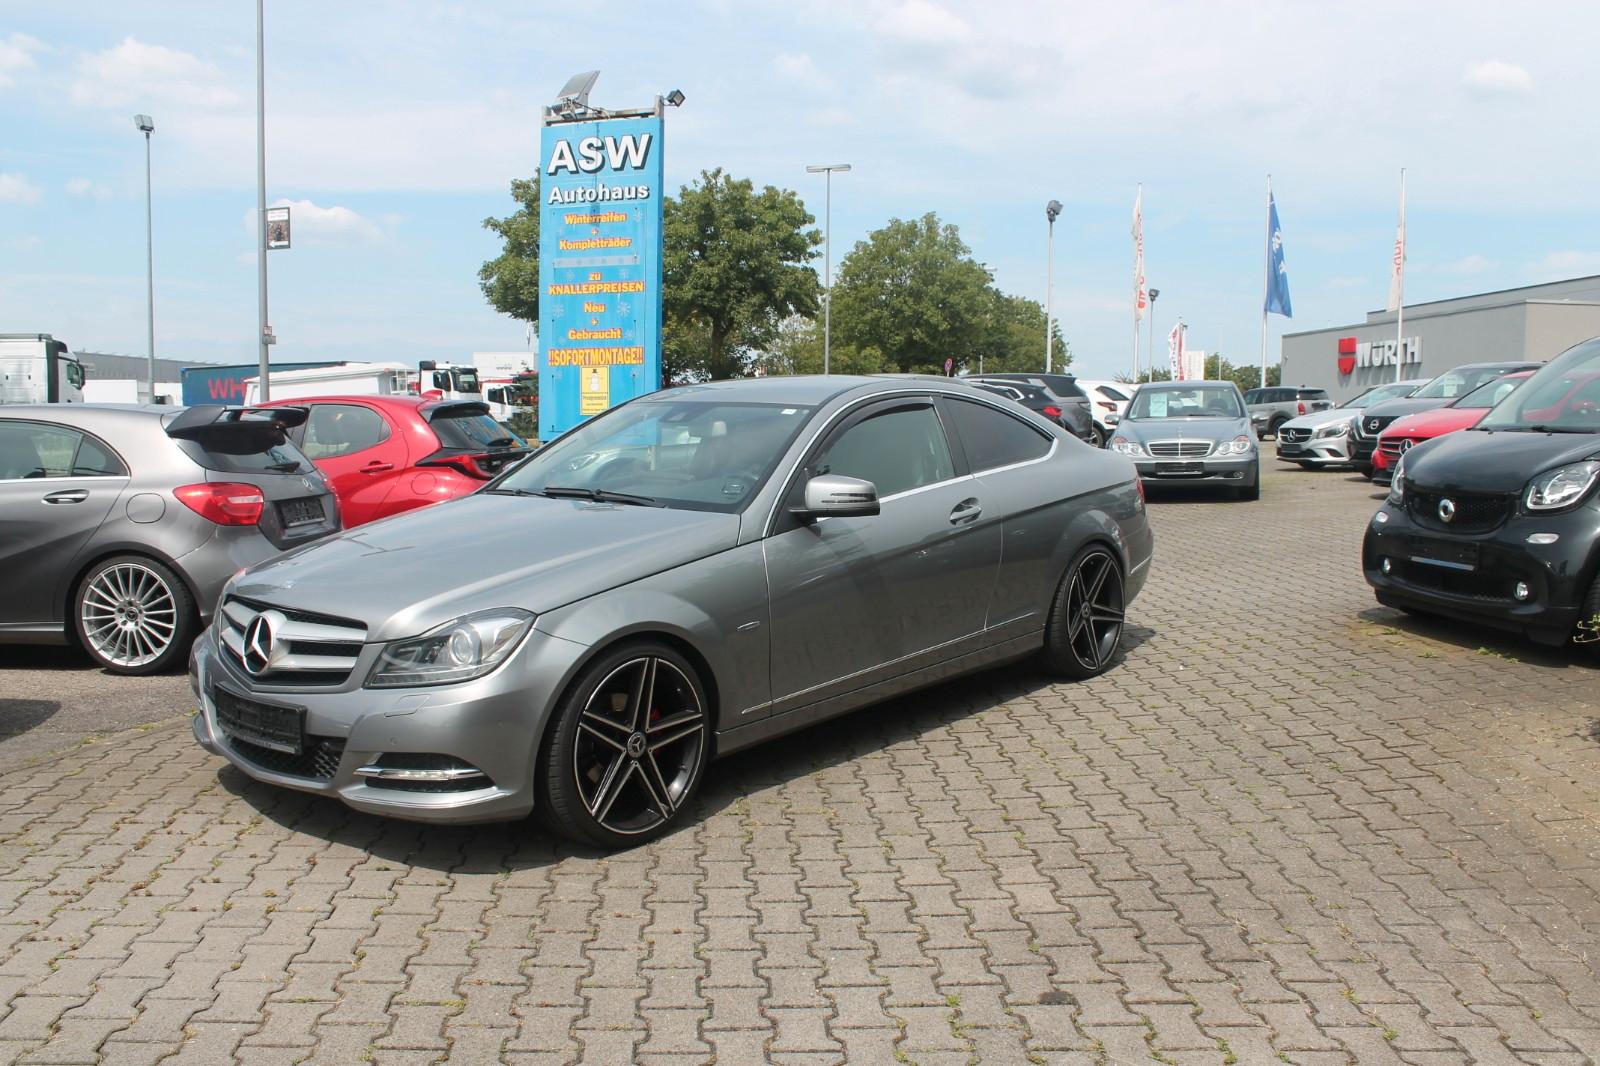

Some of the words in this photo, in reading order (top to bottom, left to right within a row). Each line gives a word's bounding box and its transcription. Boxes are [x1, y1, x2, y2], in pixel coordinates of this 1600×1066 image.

[547, 133, 652, 175] ASW
[548, 183, 650, 205] Autohaus
[564, 211, 627, 225] Winterreifen
[559, 237, 632, 251] Kompletträder
[589, 272, 602, 281] zu
[549, 281, 644, 295] KNALLERPREISEN
[583, 302, 606, 313] Neu
[567, 328, 622, 340] Gebraucht
